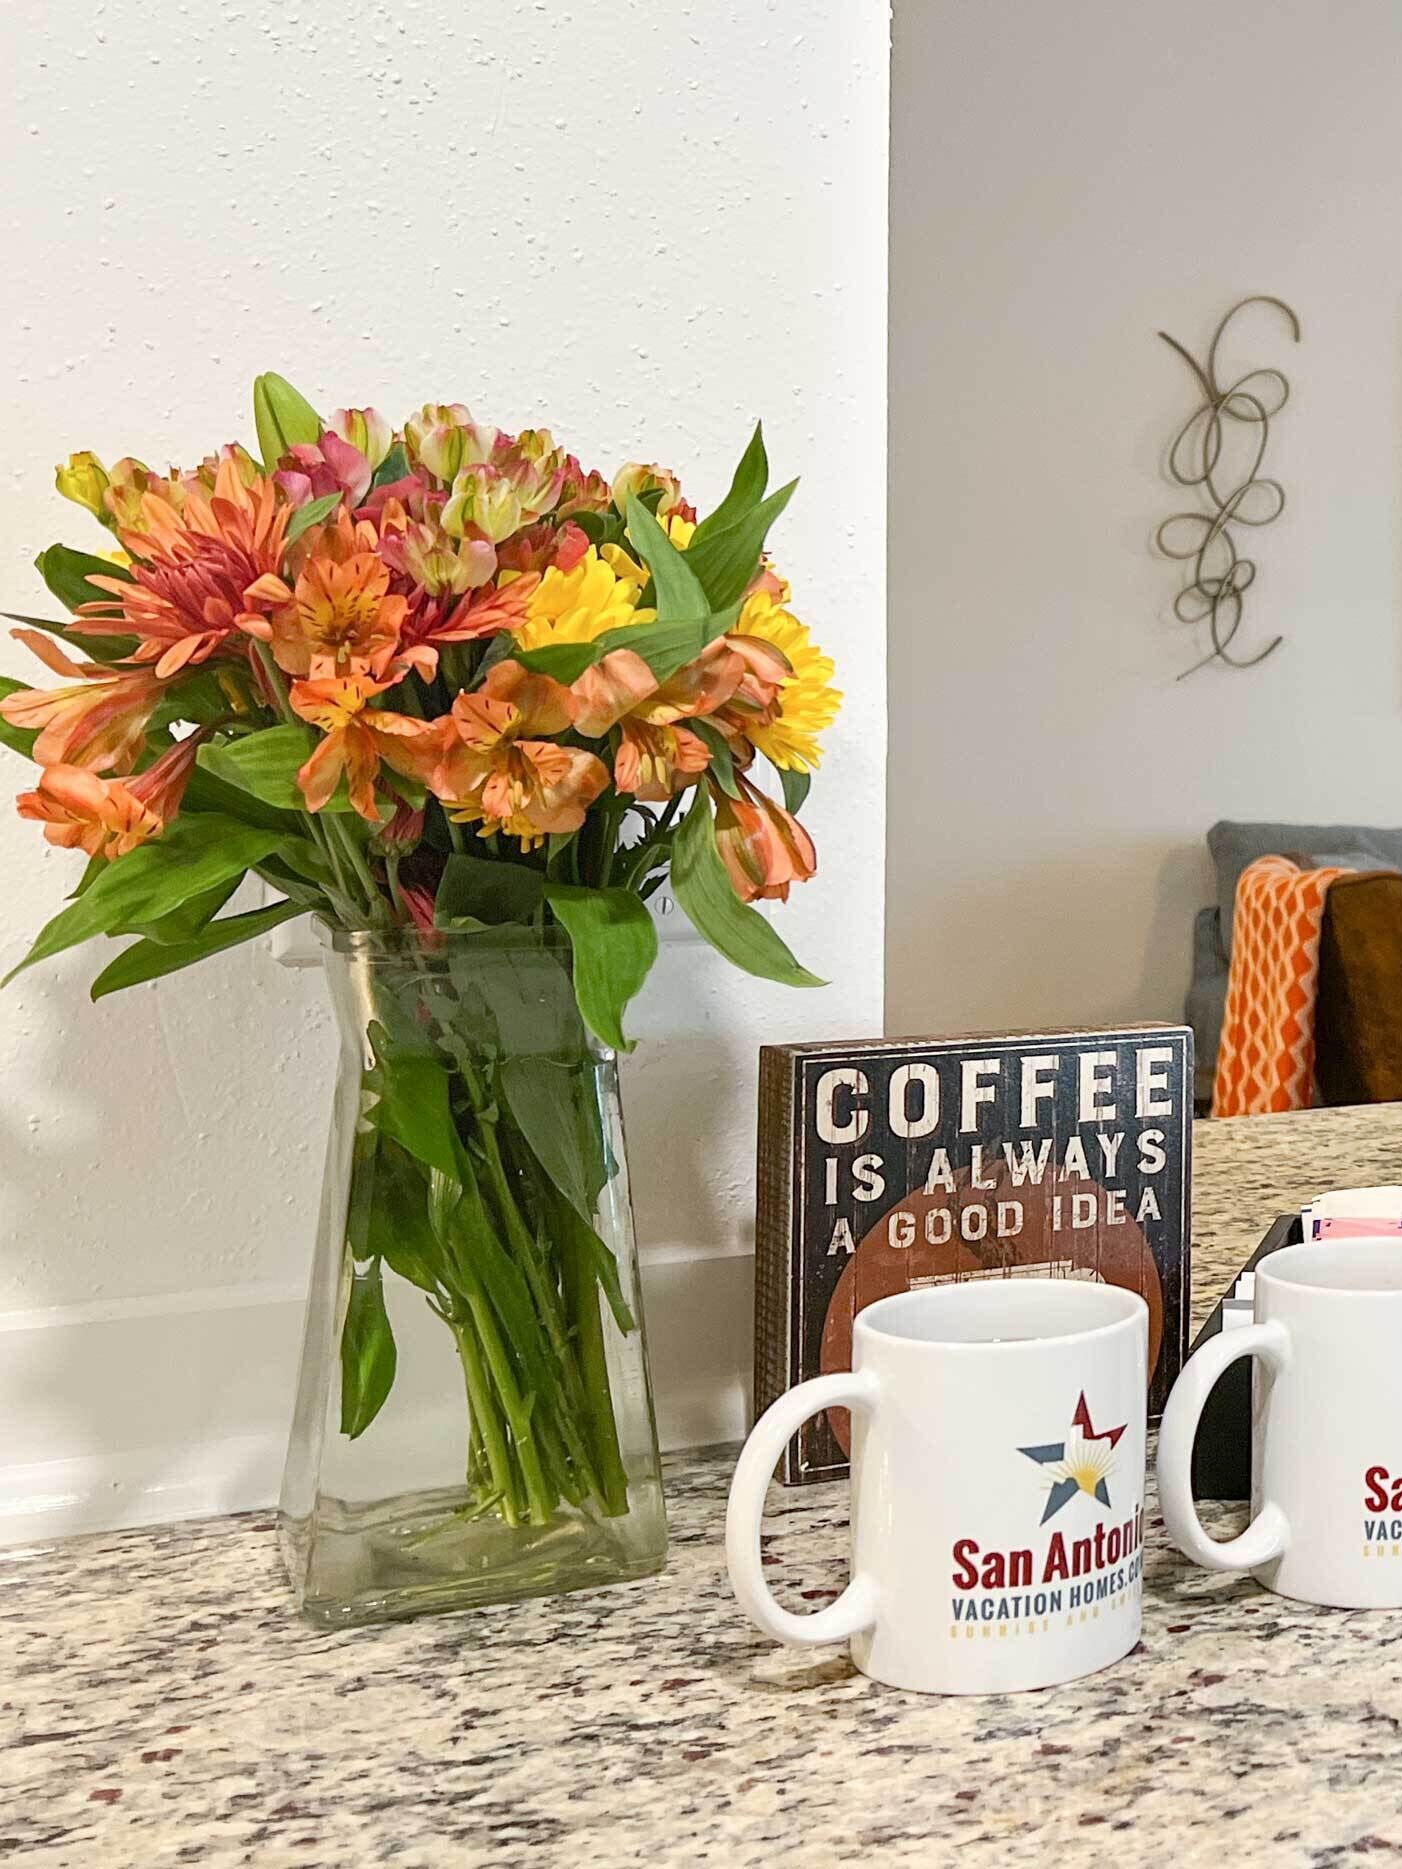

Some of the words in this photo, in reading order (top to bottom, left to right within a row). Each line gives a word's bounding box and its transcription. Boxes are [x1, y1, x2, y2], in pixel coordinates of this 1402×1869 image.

[815, 1047, 1173, 1144] COFFEE
[825, 1153, 886, 1205] IS
[922, 1128, 1168, 1196] ALWAYS
[826, 1217, 857, 1257] A
[888, 1200, 1024, 1249] GOOD
[1052, 1186, 1163, 1232] IDEA
[952, 1539, 1033, 1590] San
[952, 1590, 1062, 1621] VACATION
